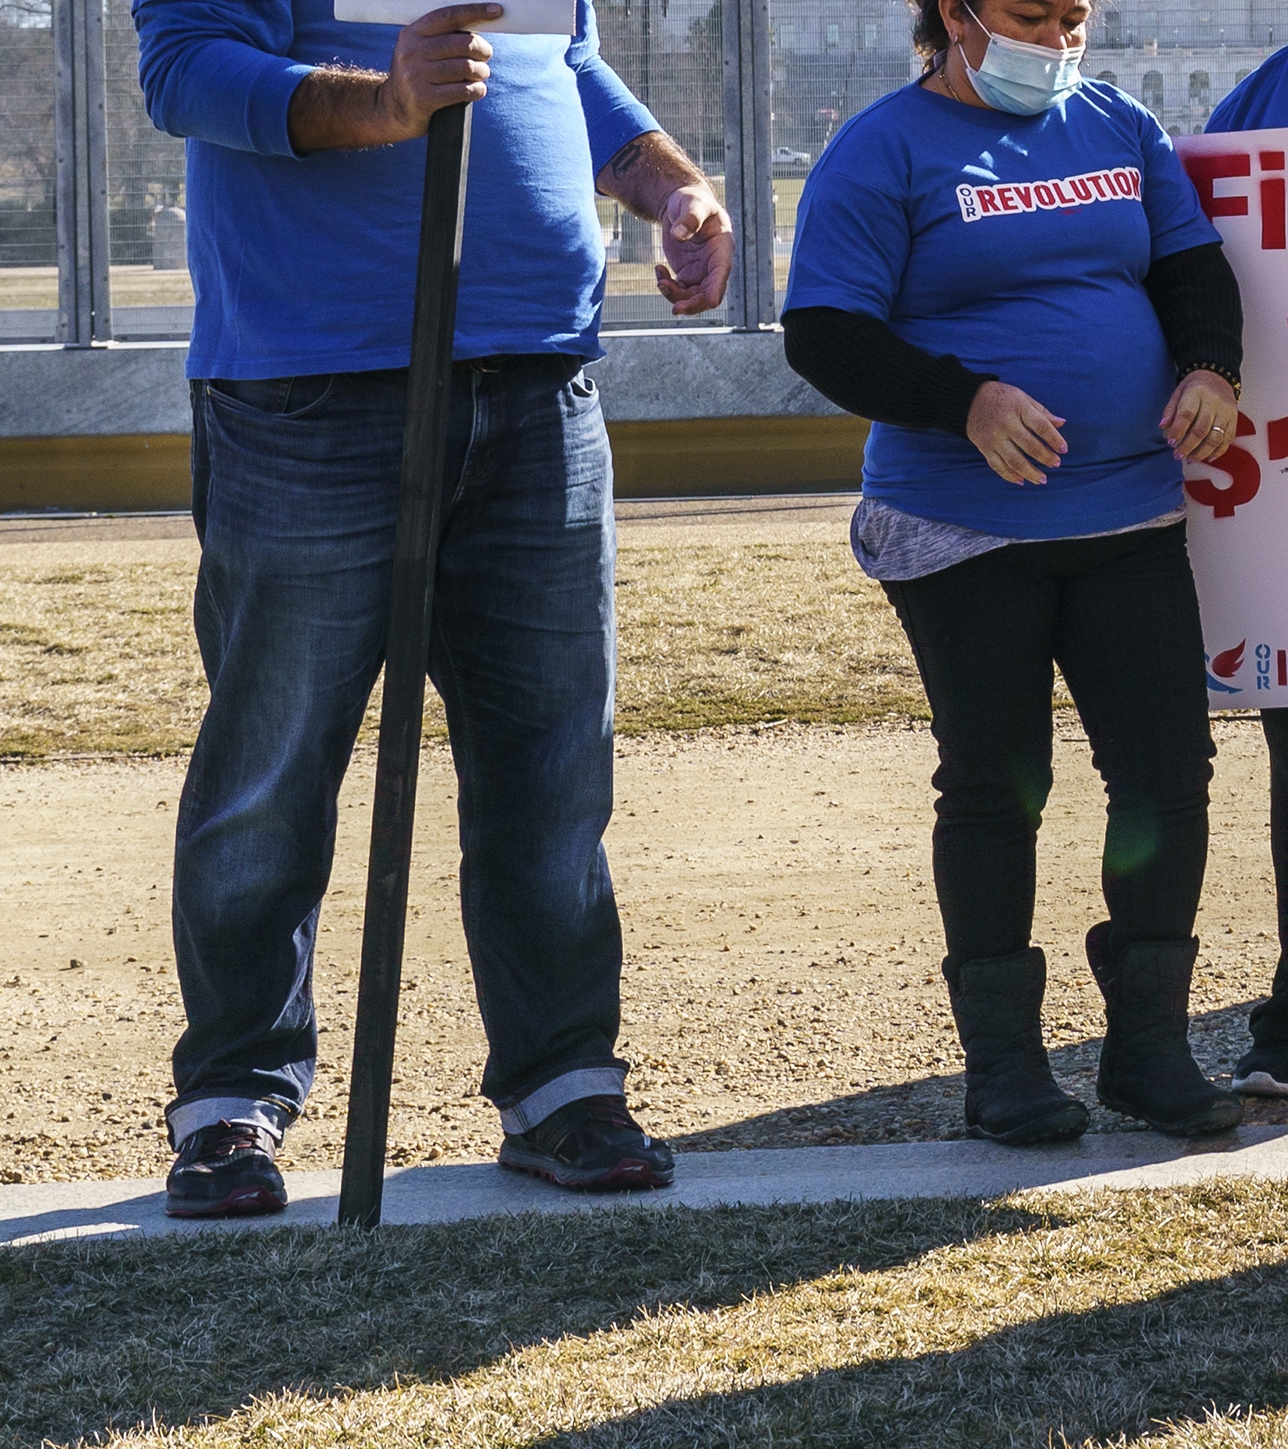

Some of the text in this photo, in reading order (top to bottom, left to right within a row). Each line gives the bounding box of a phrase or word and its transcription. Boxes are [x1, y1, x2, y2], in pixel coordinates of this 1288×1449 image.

[959, 169, 1141, 218] OUR REVOLUTION
[1254, 643, 1271, 690] OUR
